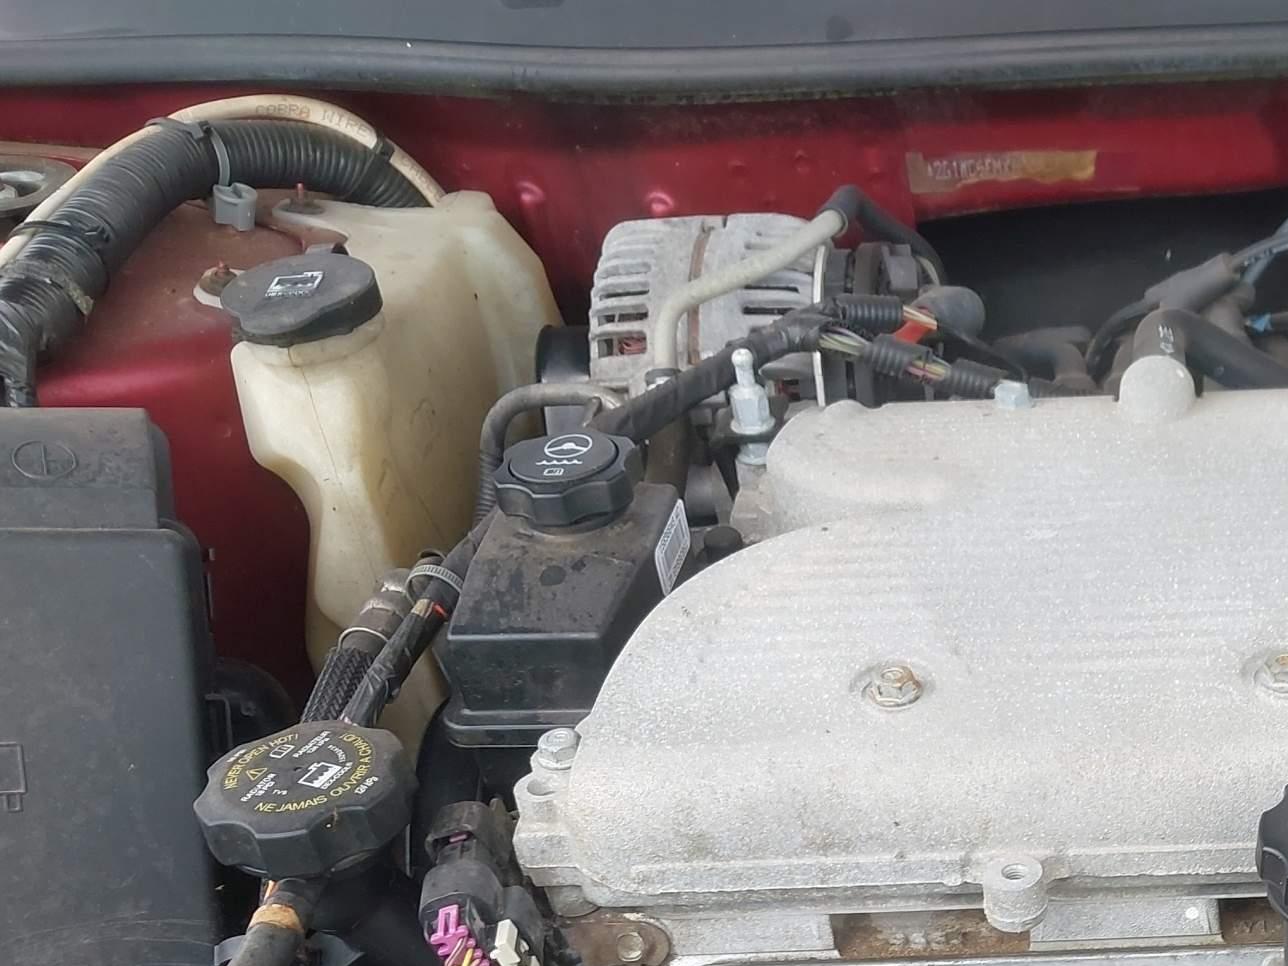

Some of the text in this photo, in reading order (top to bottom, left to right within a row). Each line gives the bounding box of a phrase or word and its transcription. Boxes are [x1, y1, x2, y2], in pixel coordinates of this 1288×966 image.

[322, 108, 371, 138] WIRE
[224, 764, 246, 790] NEVER
[238, 744, 270, 764] OPEN
[240, 773, 277, 801] RADIATOR
[253, 802, 276, 812] NE
[275, 795, 327, 813] JAMAIS
[330, 765, 370, 797] OUVRIR
